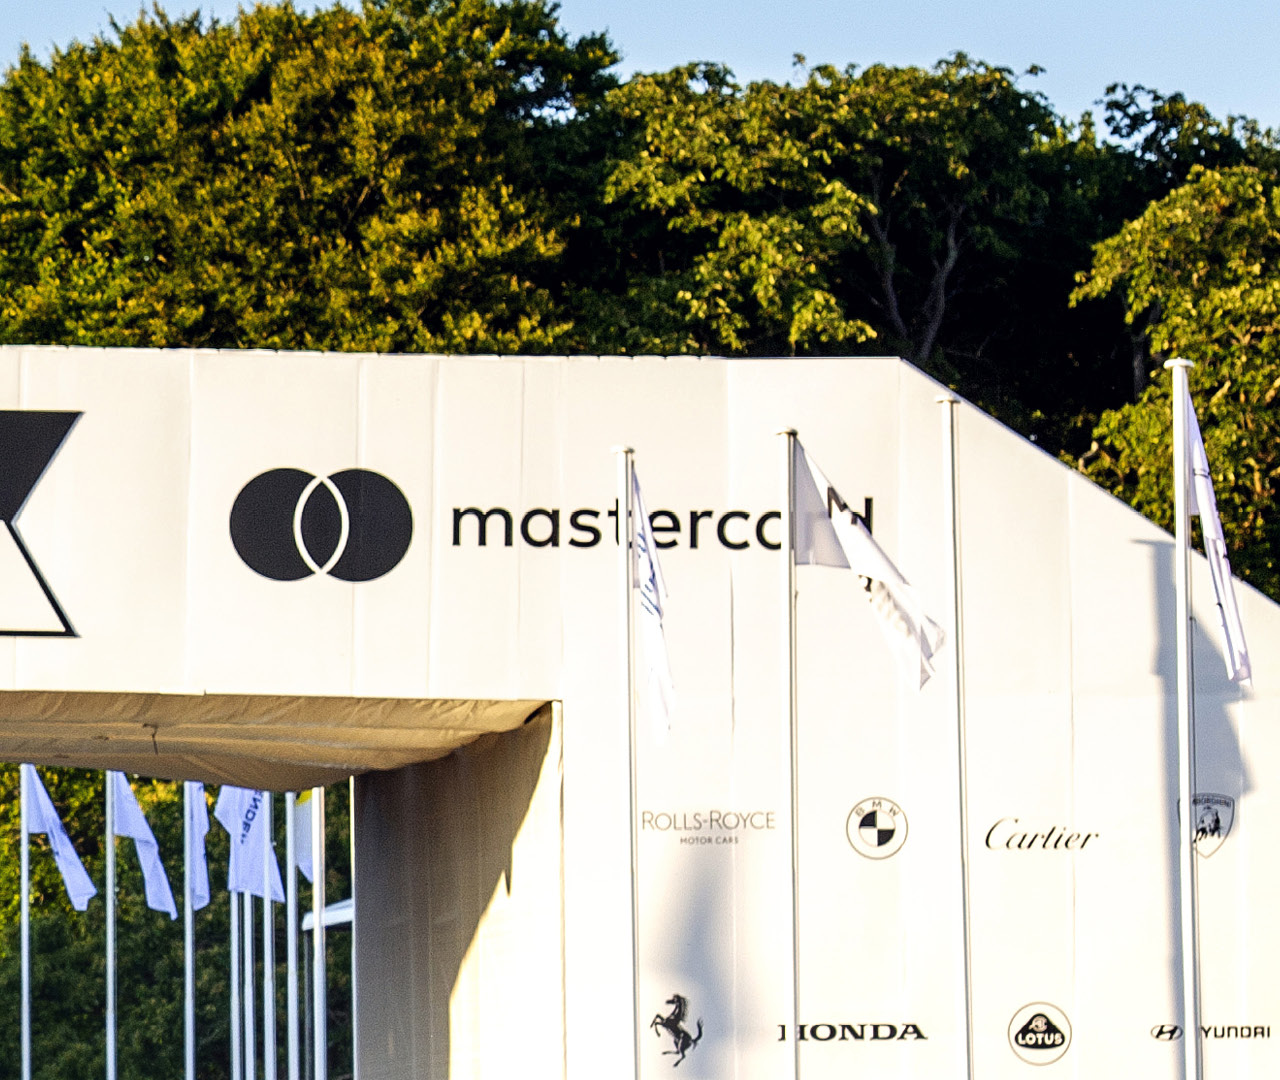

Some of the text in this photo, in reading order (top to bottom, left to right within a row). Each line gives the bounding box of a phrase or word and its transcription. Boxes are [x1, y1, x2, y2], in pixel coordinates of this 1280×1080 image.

[854, 799, 901, 817] BMW
[641, 809, 776, 831] ROLLS-ROYCE
[679, 835, 739, 846] MOTOR CARS
[984, 816, 1100, 851] Cartier
[1017, 1032, 1063, 1046] LOTUS
